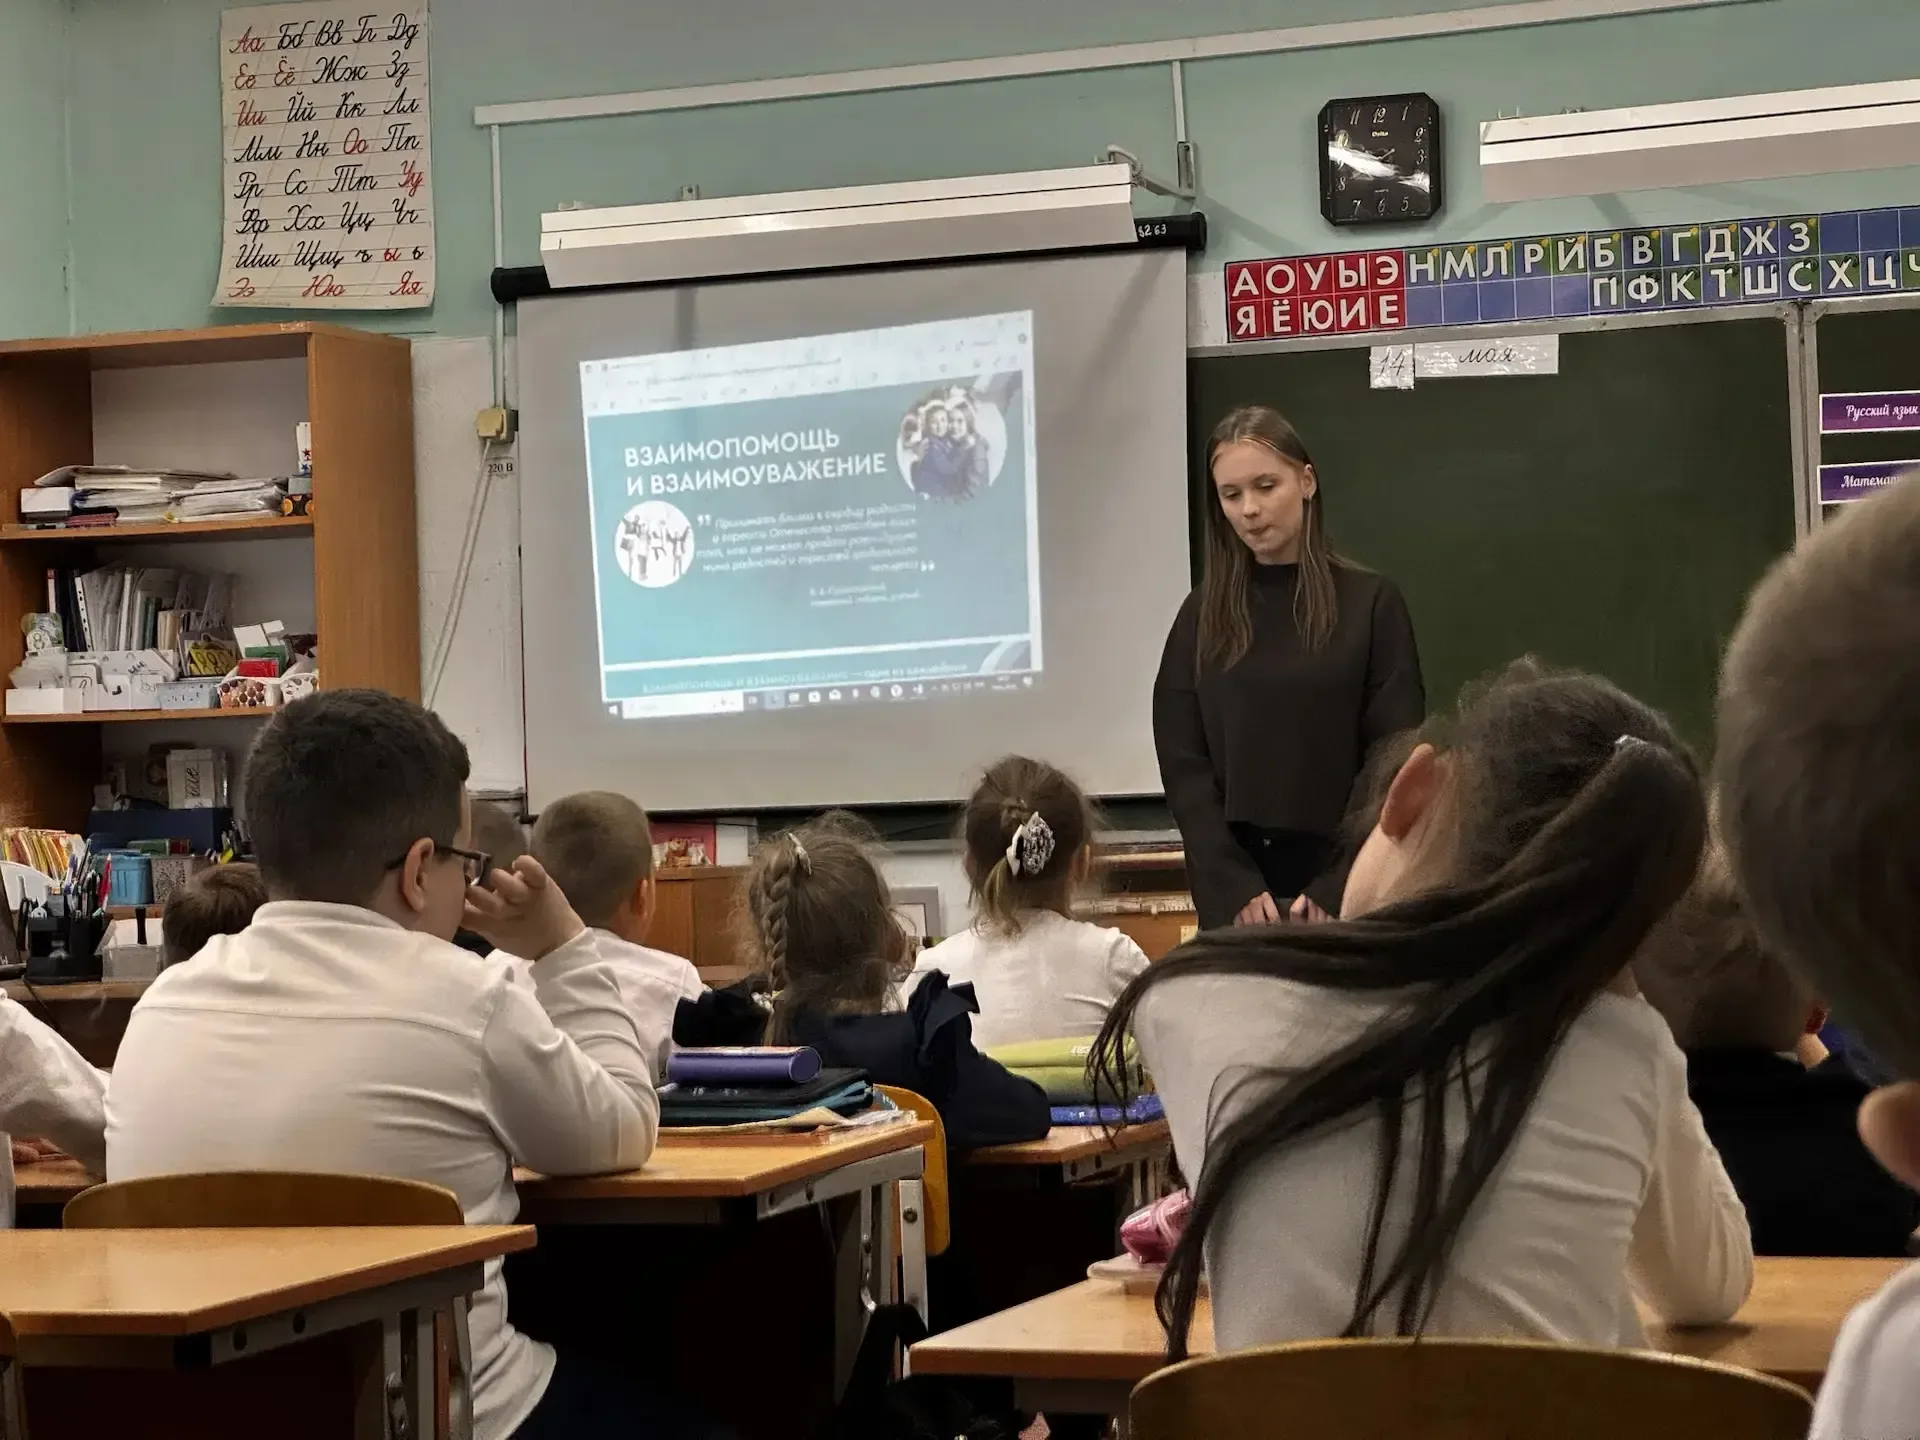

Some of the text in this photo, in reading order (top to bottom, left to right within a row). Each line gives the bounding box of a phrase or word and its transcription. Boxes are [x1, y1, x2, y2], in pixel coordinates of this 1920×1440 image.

[229, 13, 418, 53] Аа Бб Вв Гг Дд
[235, 50, 409, 89] Ее Ёё Жж Зз
[237, 87, 419, 126] Ии Йй Кк Лл
[1373, 107, 1387, 123] 12
[233, 122, 420, 162] Мм Нн Оо Пп
[234, 160, 423, 209] Рр Сс Тт Уу
[236, 198, 419, 243] Фф Хх Цц Чч
[236, 240, 424, 272] Шш Щщ ъ ы ь
[228, 270, 423, 298] Ээ Юю Яя
[1459, 347, 1517, 364] мая
[1846, 404, 1919, 422] Русский язык
[624, 428, 840, 469] ВЗАИМОПОМОЩЬ
[626, 452, 887, 497] И ВЗАИМОУВАЖЕНИЕ
